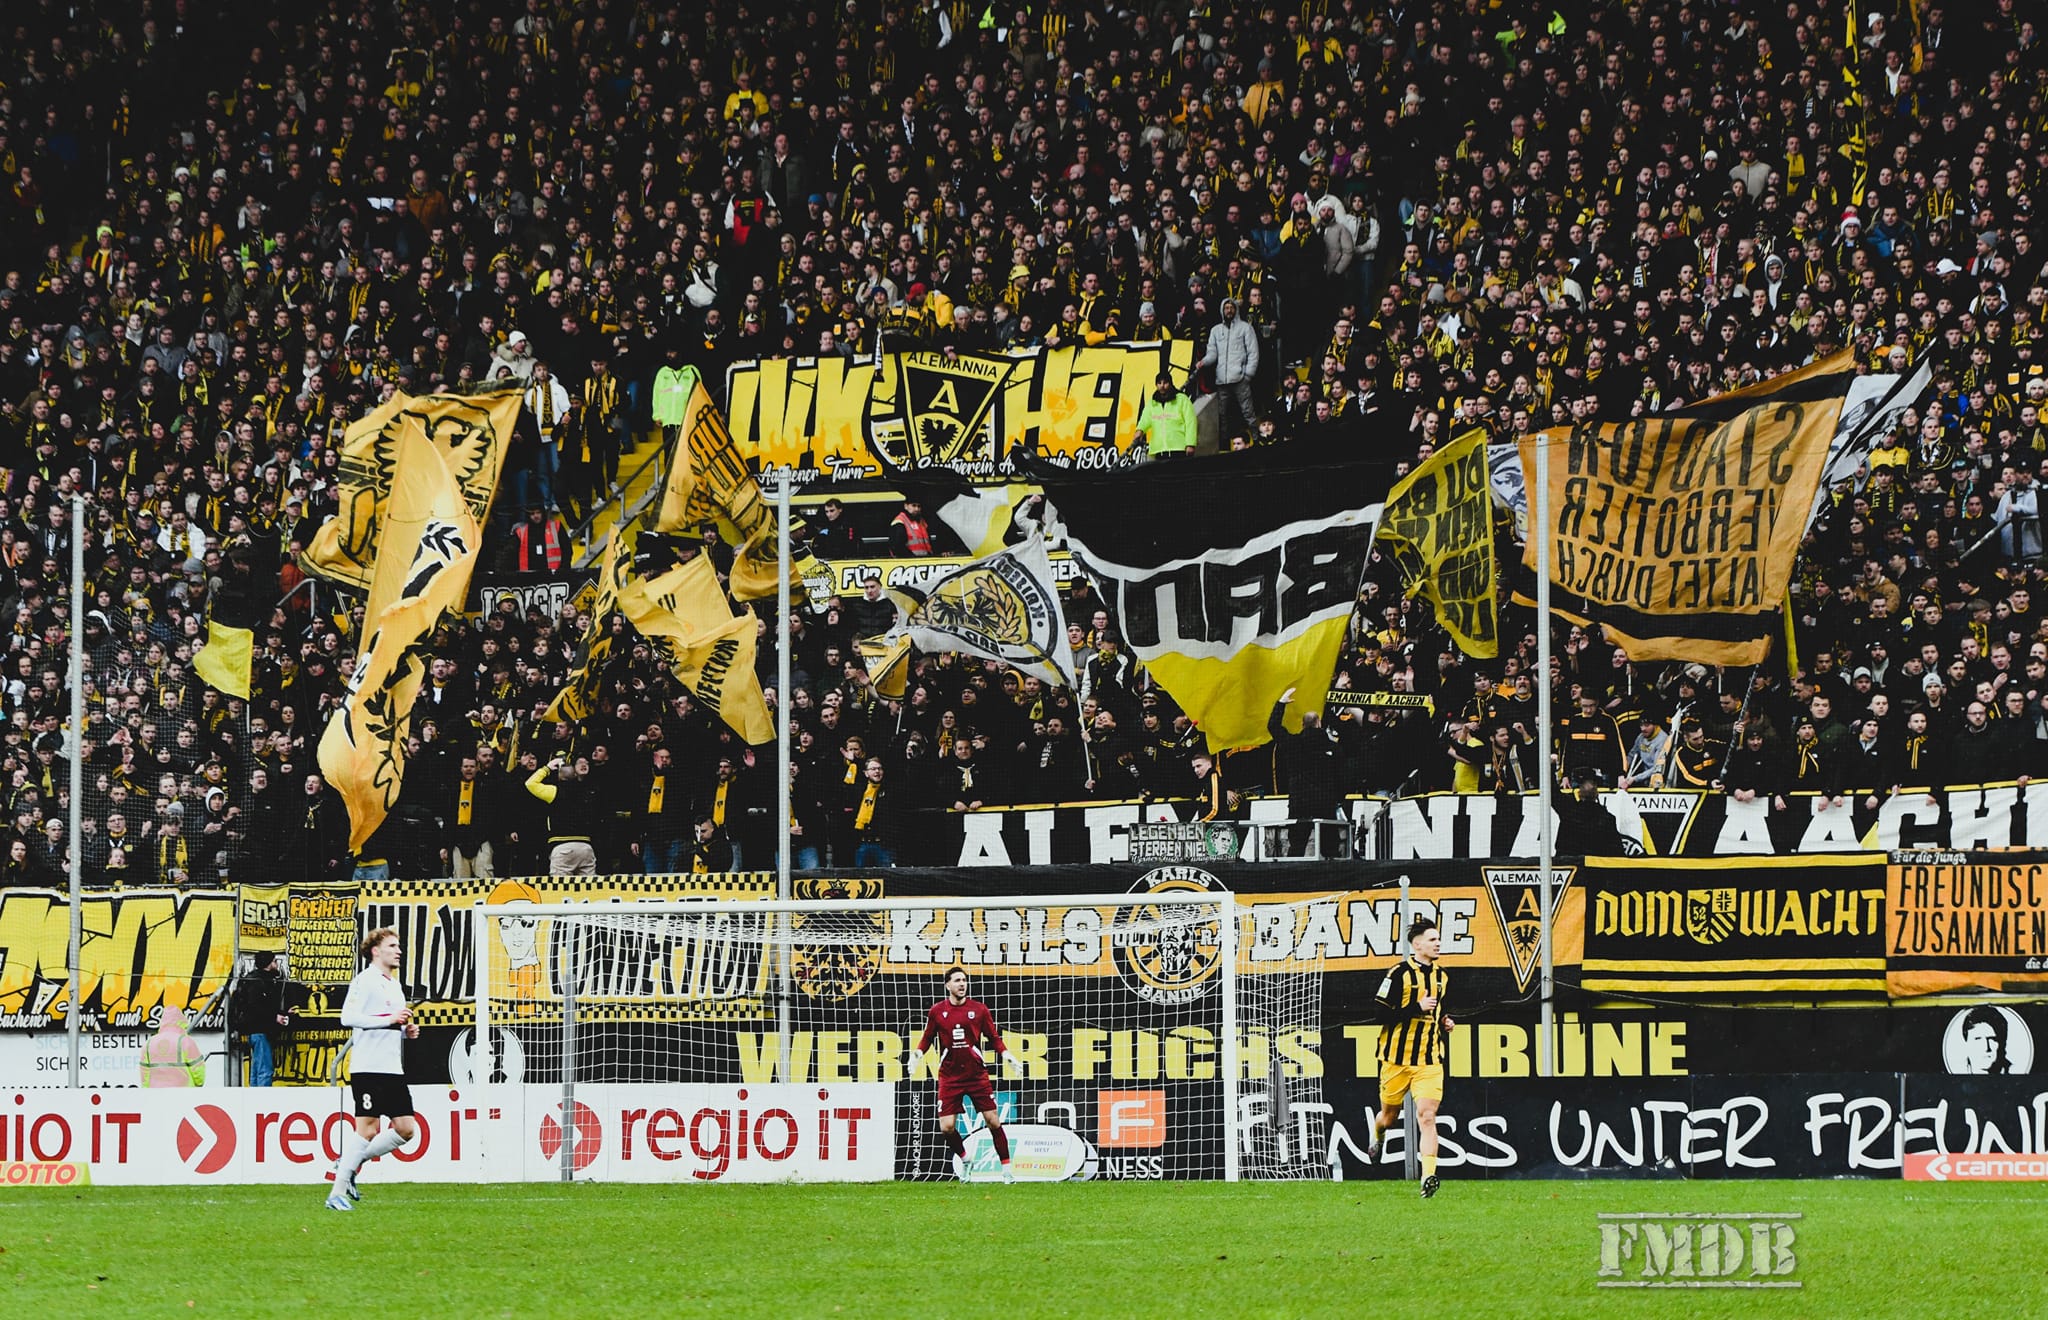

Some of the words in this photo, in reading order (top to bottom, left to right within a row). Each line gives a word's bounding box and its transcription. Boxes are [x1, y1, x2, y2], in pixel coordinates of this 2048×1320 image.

[907, 351, 998, 378] ALEMANNIA
[928, 379, 960, 414] A
[823, 456, 876, 484] Turn-
[841, 564, 881, 590] FÜR
[1385, 695, 1424, 706] AACHEN
[1129, 824, 1204, 841] LEGENDEN
[1129, 840, 1182, 858] STERBEN
[1184, 841, 1207, 858] NIE!
[1145, 867, 1212, 888] KARLS
[1492, 873, 1565, 884] ALEMANIA
[289, 898, 355, 918] FREIHEIT
[1515, 887, 1542, 918] A
[1738, 888, 1886, 937] WACHT
[240, 925, 287, 937] ERHALTEN
[289, 931, 354, 945] SICHERHEIT
[887, 908, 1103, 965] KARLS
[1250, 898, 1476, 961] BANDE
[1893, 910, 2046, 955] ZUSAMMEN
[301, 969, 353, 980] VERLIEREN
[1138, 983, 1204, 1004] BANDE
[115, 1006, 143, 1028] und
[92, 1034, 148, 1049] BESTEL
[1343, 1012, 1688, 1079] TIBÜNE
[37, 1056, 88, 1071] SICHR
[361, 1092, 373, 1111] 8
[621, 1088, 799, 1181] regio
[818, 1088, 872, 1161] iT
[1549, 1095, 1777, 1168] UNTER
